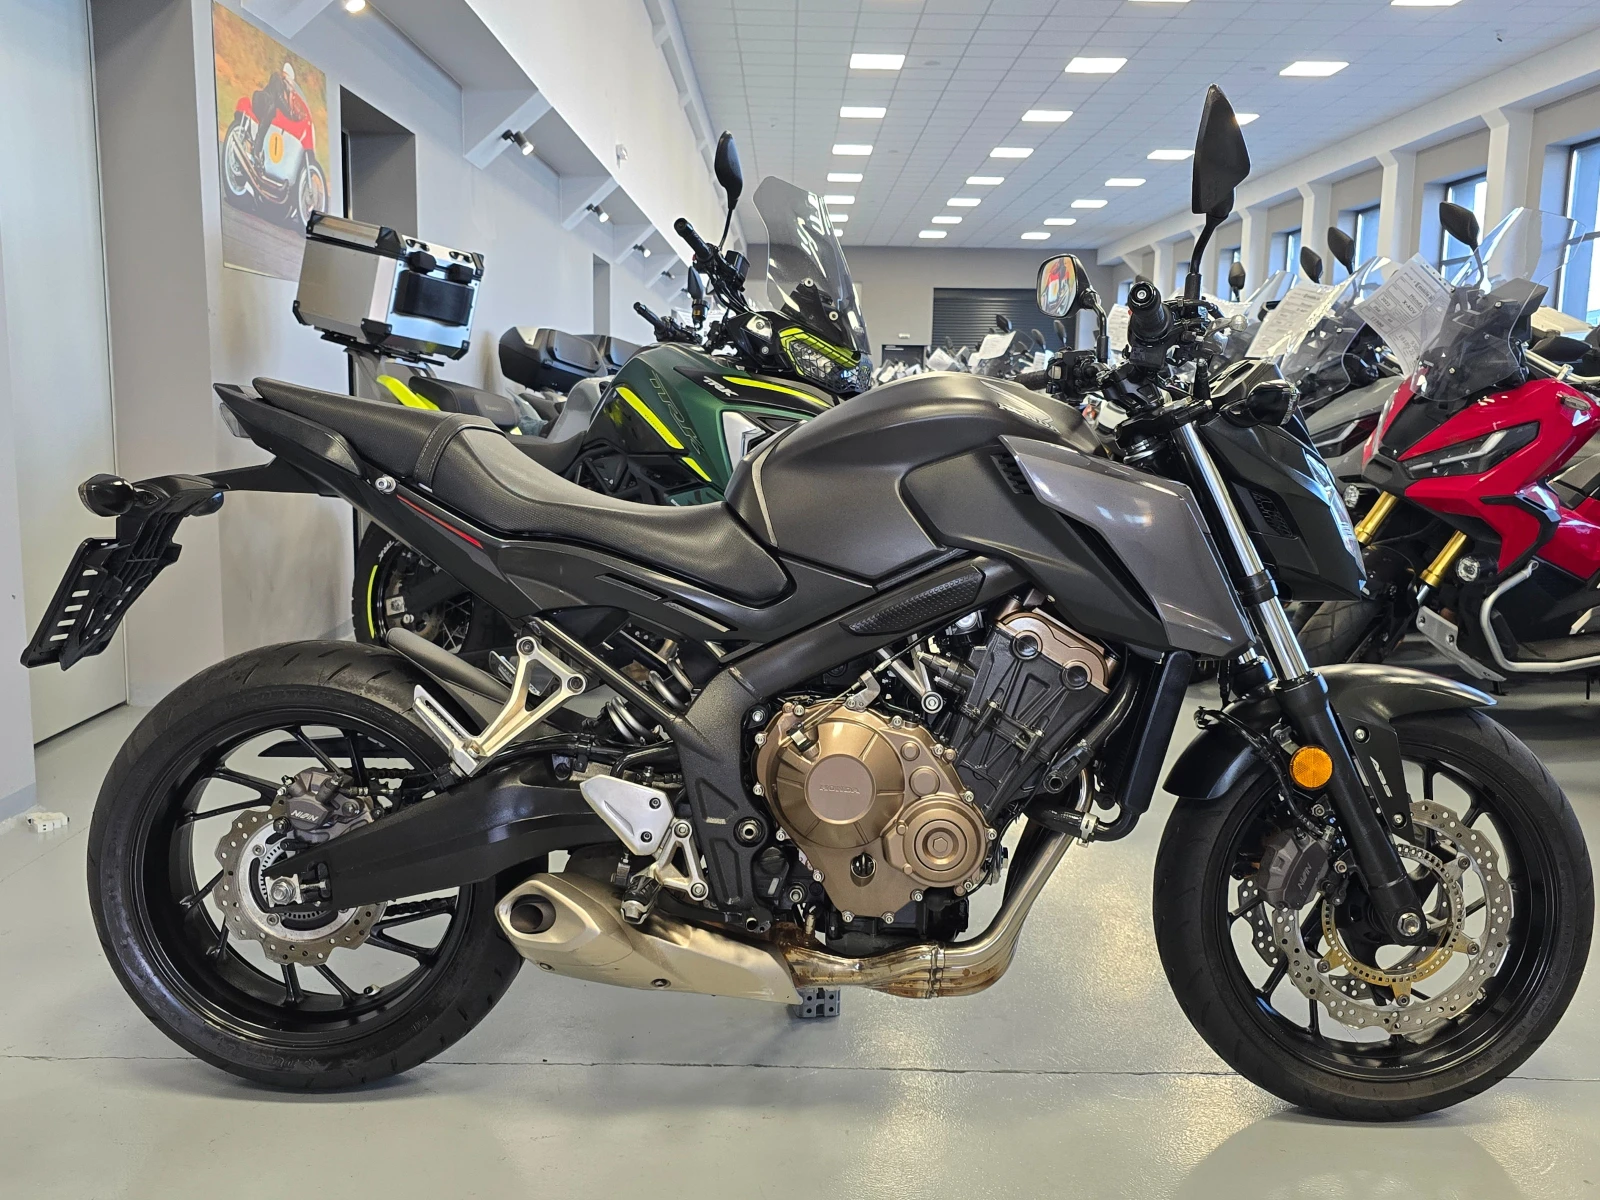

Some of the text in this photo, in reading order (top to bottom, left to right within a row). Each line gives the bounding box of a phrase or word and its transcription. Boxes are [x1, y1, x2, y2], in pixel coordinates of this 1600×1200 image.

[1402, 299, 1417, 314] X-ADV
[703, 375, 739, 397] TRK
[819, 784, 861, 795] HONDA
